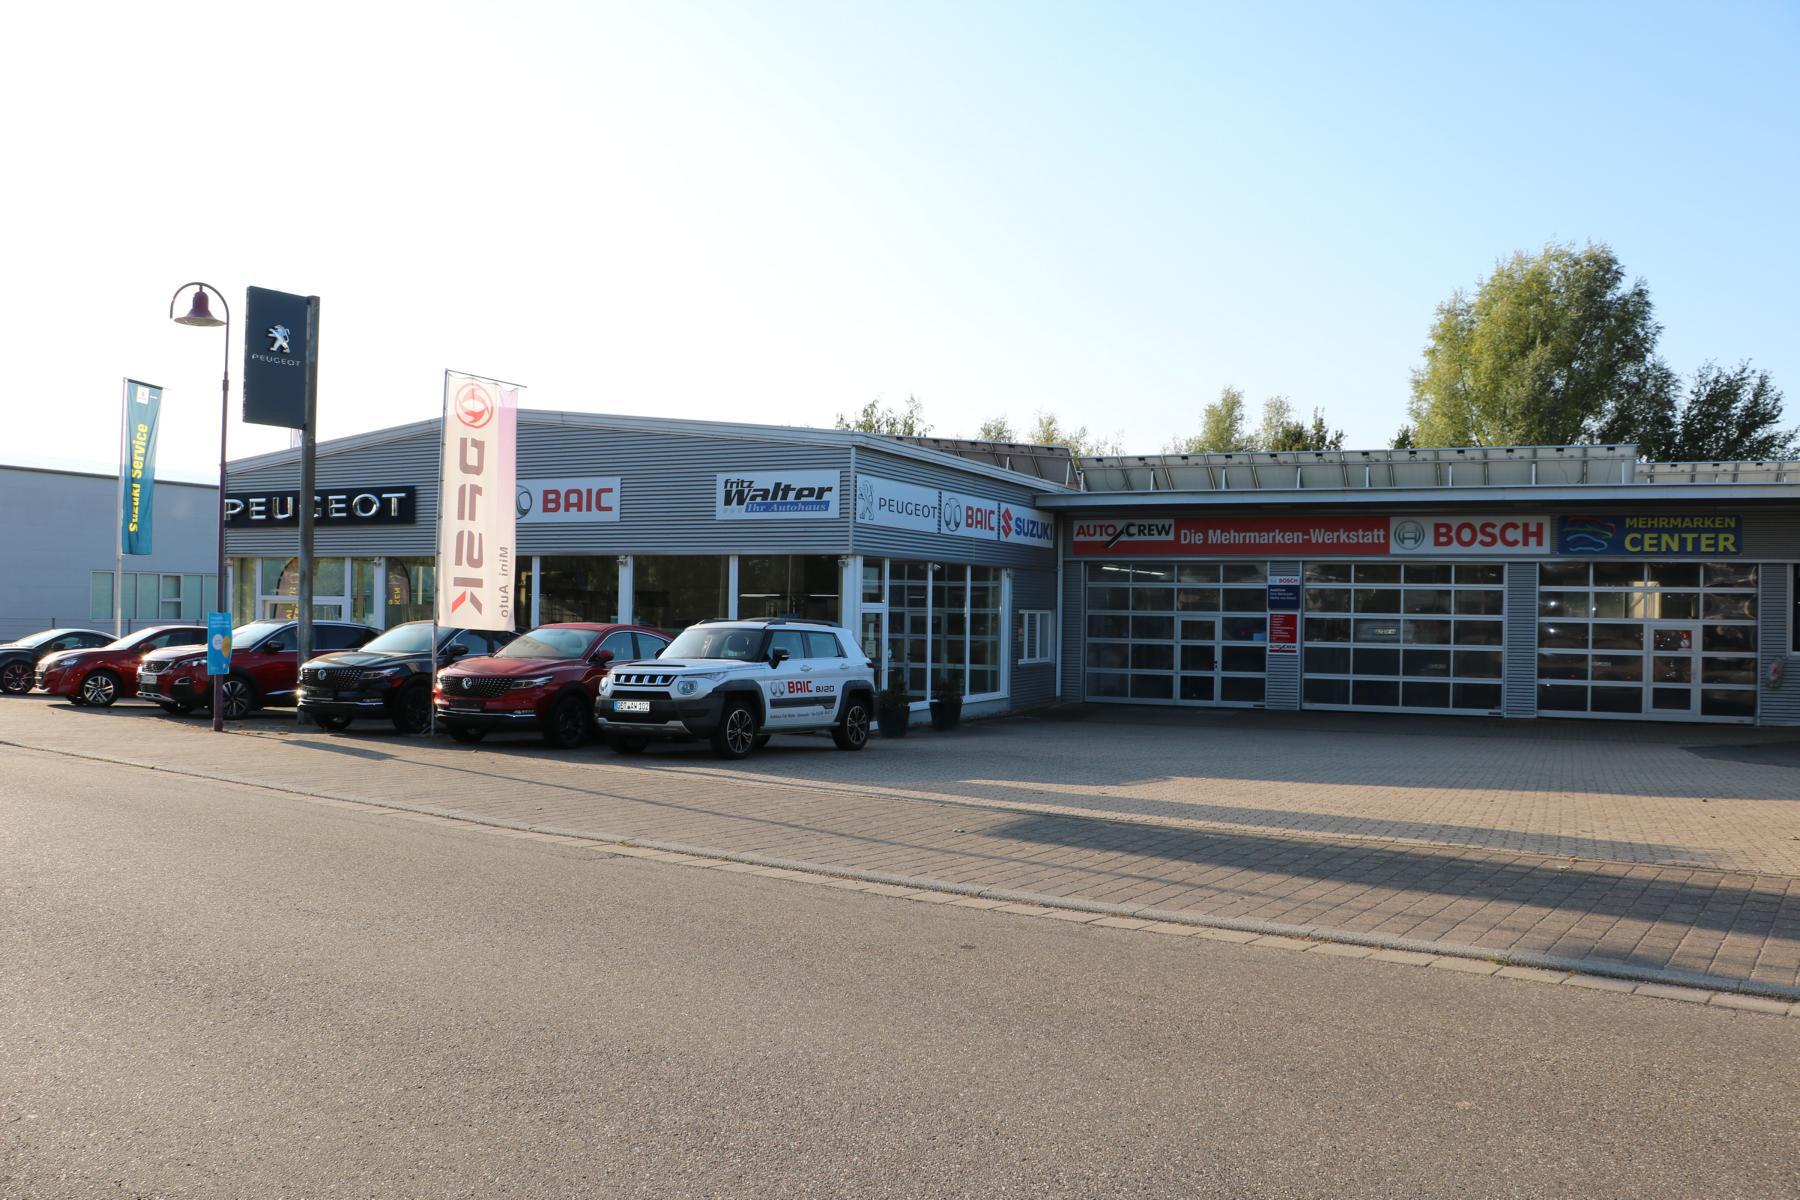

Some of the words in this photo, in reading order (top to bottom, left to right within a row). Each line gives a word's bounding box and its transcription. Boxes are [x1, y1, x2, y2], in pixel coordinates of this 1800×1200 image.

[251, 353, 302, 366] PEUGEOT
[131, 423, 149, 480] Service
[723, 481, 833, 507] Walter
[724, 479, 756, 489] fritz
[542, 487, 614, 513] BAIC
[747, 502, 766, 512] Ihr
[768, 502, 827, 512] Autohaus
[878, 497, 938, 520] PEUGEOT
[965, 505, 996, 531] BAIC
[1625, 516, 1736, 529] MEHRMARKEN
[1014, 517, 1054, 541] SUZUKI
[1076, 523, 1117, 537] AUTO
[1125, 522, 1172, 537] CREW
[1180, 529, 1204, 544] Die
[1208, 528, 1385, 544] Mehrmarken-Werkstatt
[1433, 521, 1544, 548] BOSCH
[1624, 532, 1737, 552] CENTER
[787, 681, 813, 693] BAIC
